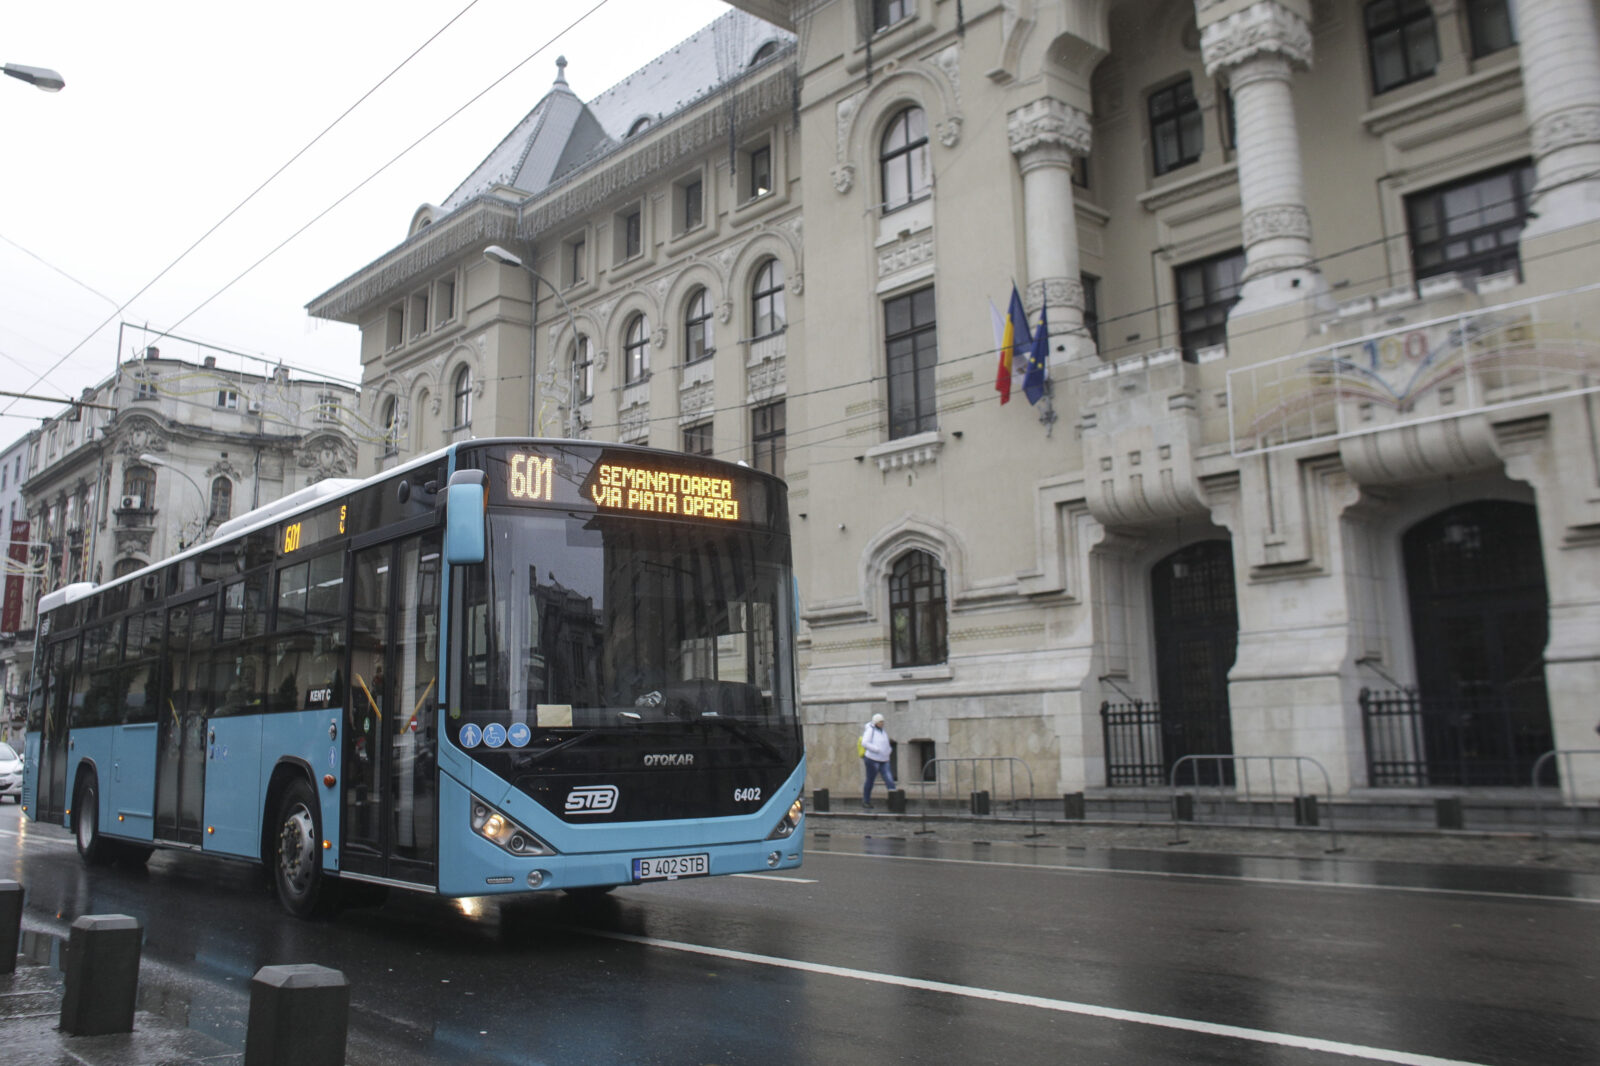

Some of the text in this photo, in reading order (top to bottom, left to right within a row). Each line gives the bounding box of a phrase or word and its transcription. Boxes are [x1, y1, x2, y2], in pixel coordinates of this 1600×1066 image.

[1363, 330, 1428, 368] 100
[511, 454, 552, 500] 601
[600, 465, 732, 499] SEMANATOAREA
[592, 484, 738, 520] VIA PIATA OPEREI
[284, 522, 301, 553] 601
[310, 689, 332, 702] KENT C
[644, 754, 694, 766] OTOKAR
[564, 790, 614, 810] STB
[734, 787, 761, 801] 6402
[641, 861, 651, 876] B
